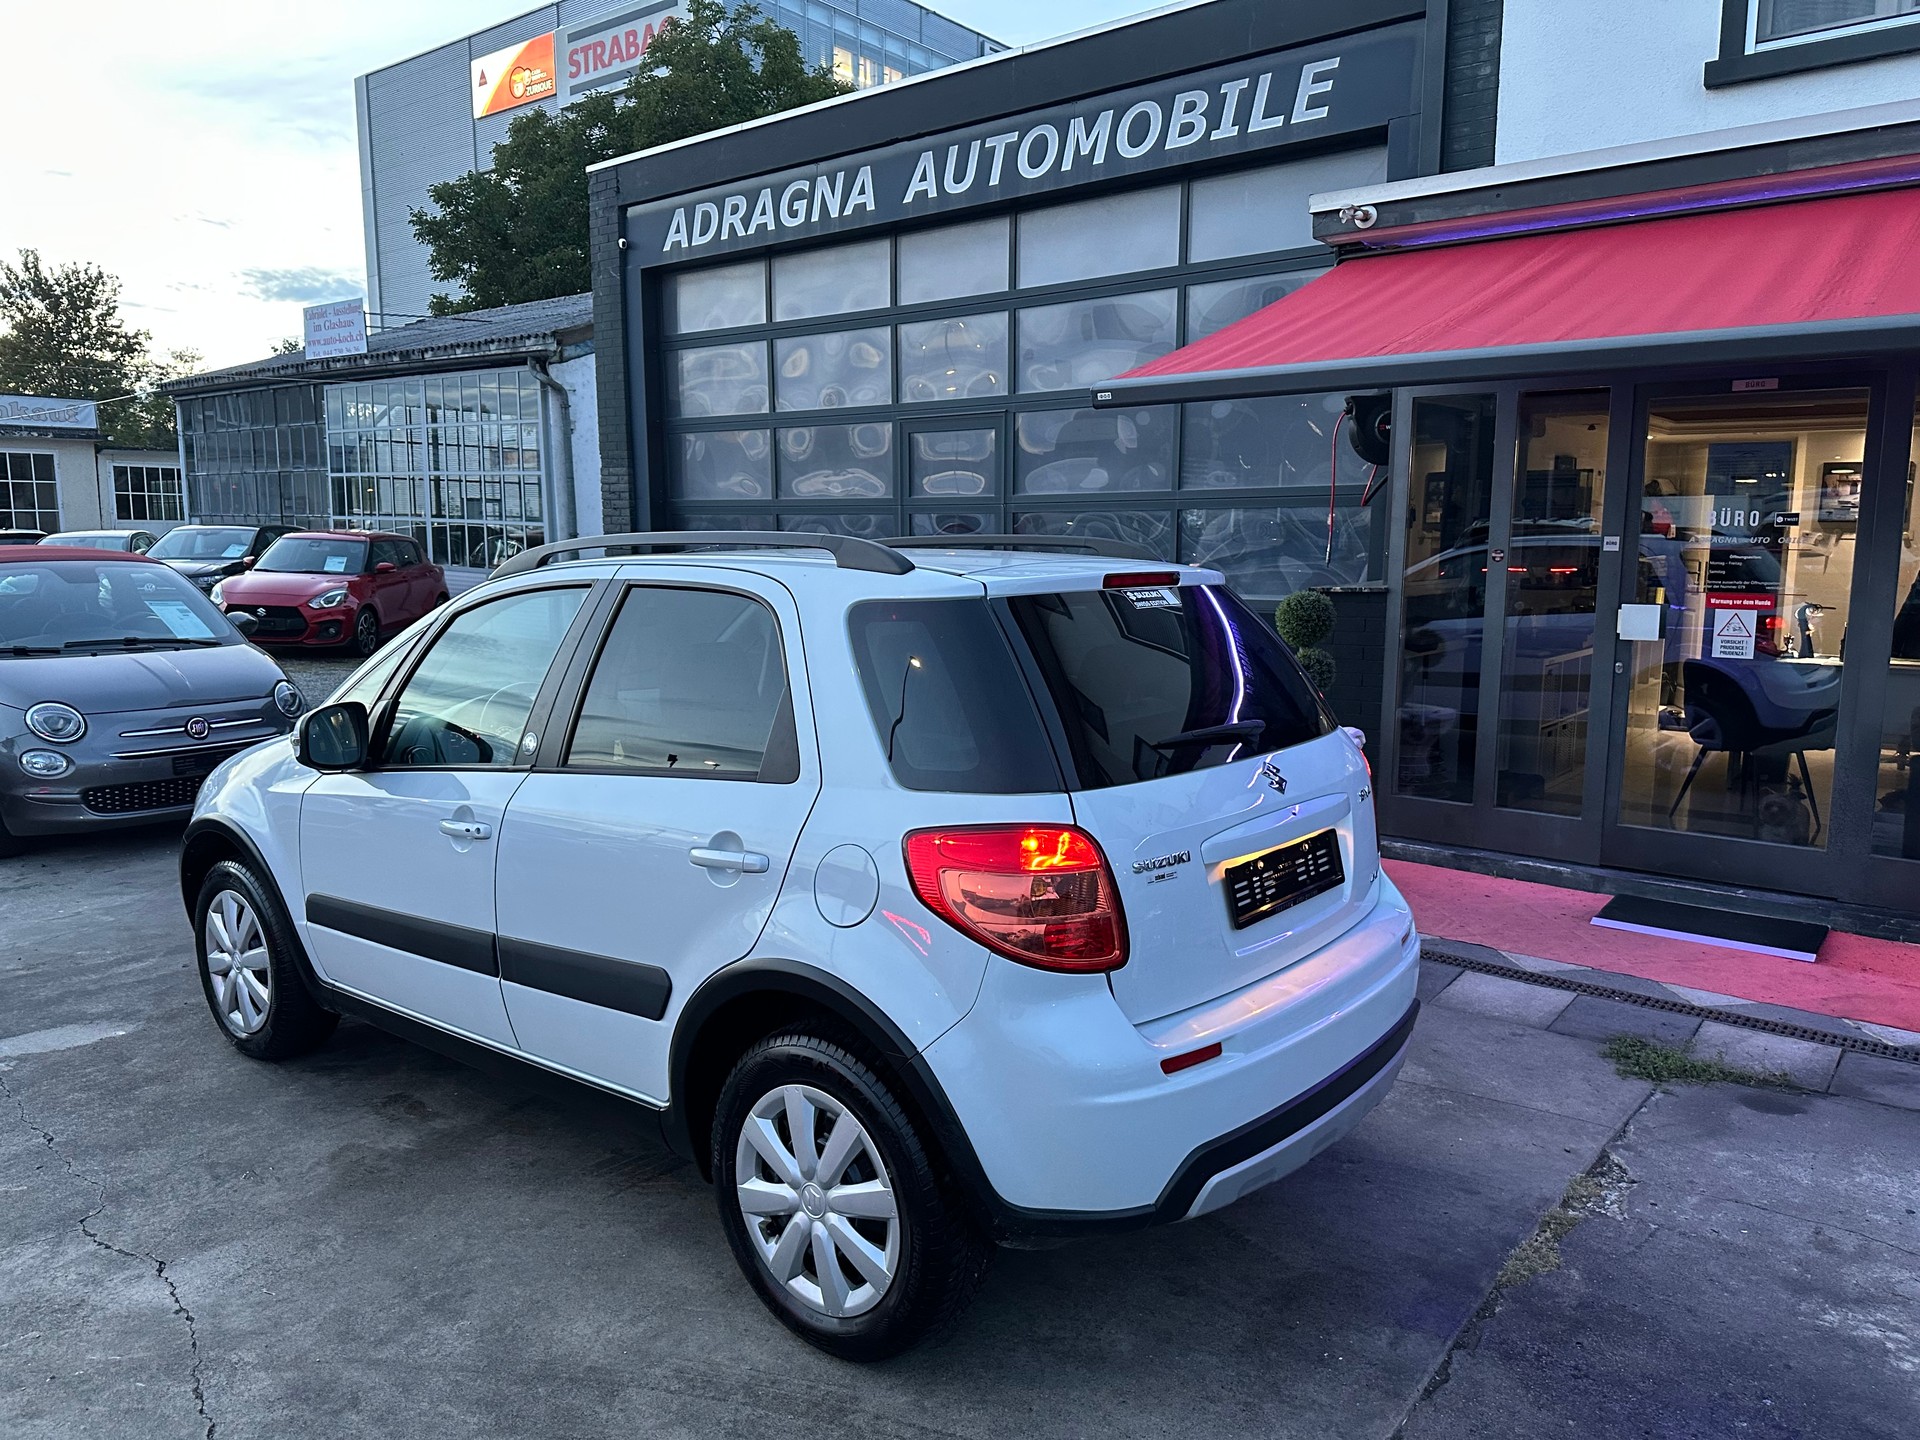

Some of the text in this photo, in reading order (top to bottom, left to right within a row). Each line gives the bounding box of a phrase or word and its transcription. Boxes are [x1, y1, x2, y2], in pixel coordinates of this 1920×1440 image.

[525, 80, 553, 97] ZURIQUE
[662, 56, 1342, 252] ADRAGNA AUTOMOBILE
[313, 318, 355, 332] im Glashaus
[307, 330, 364, 347] www.auto-koch.ch
[1707, 508, 1760, 526] BÜRO
[1132, 850, 1191, 874] SUZUKI
